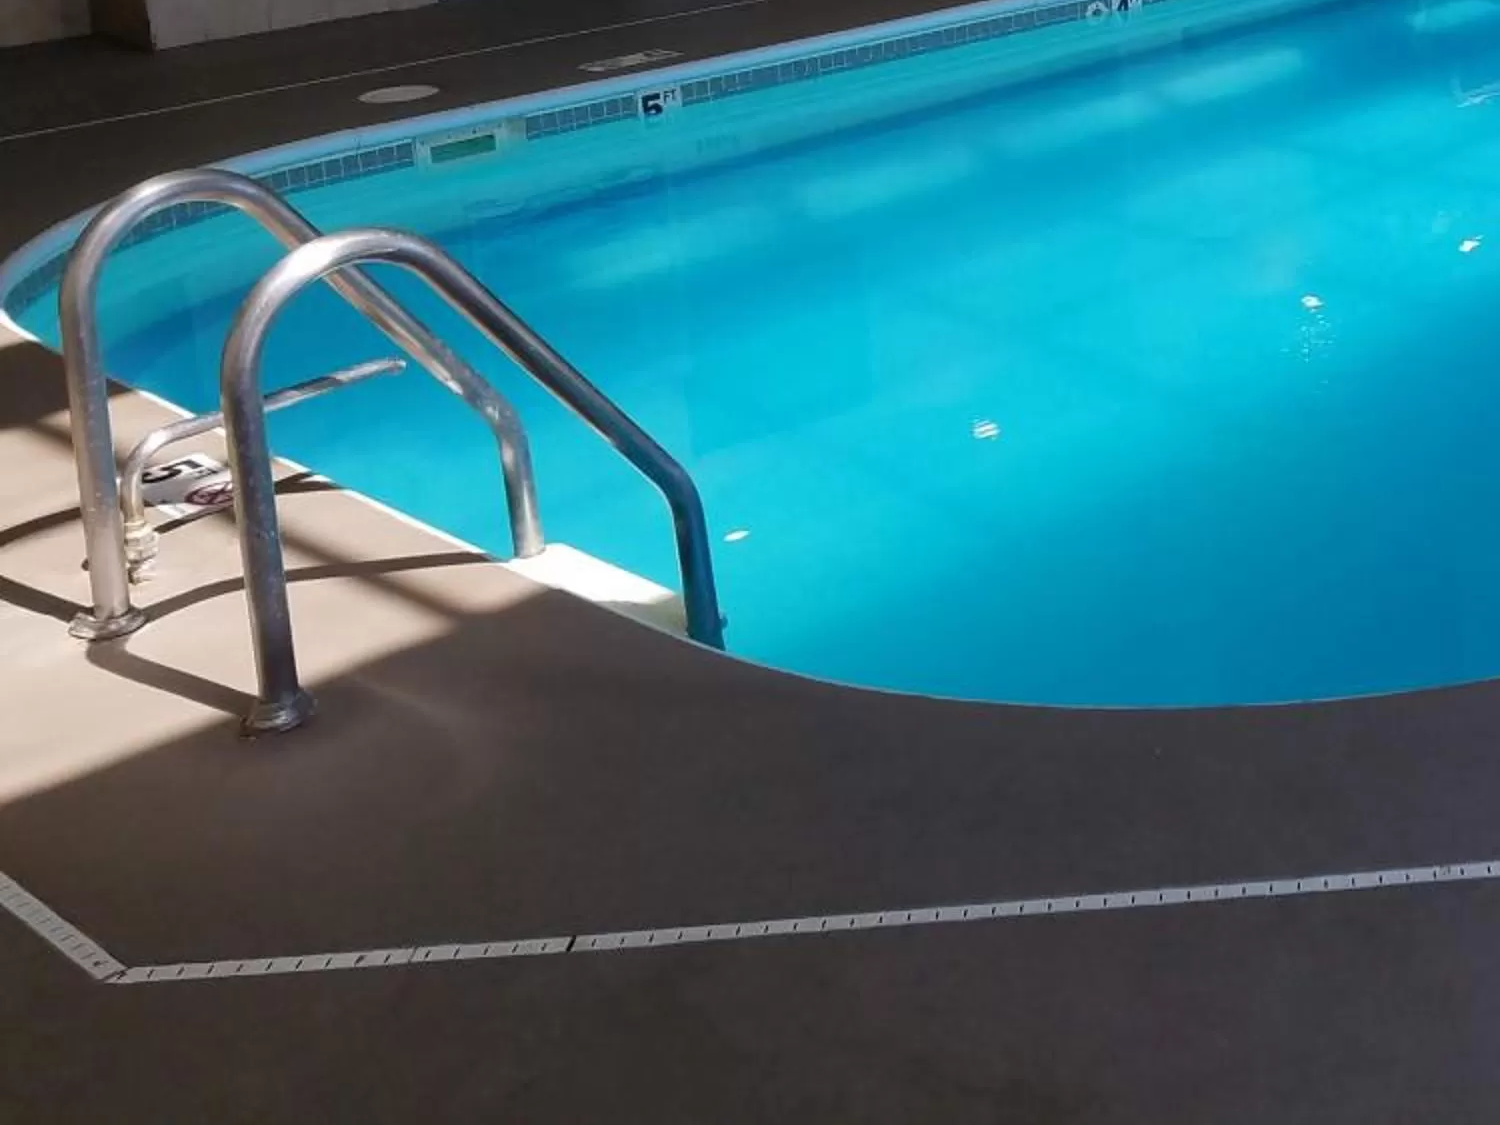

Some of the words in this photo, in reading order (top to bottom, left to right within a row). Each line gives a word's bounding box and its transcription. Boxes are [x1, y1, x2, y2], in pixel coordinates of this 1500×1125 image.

[641, 92, 664, 117] 5
[664, 88, 677, 104] FT
[142, 459, 204, 484] 5
